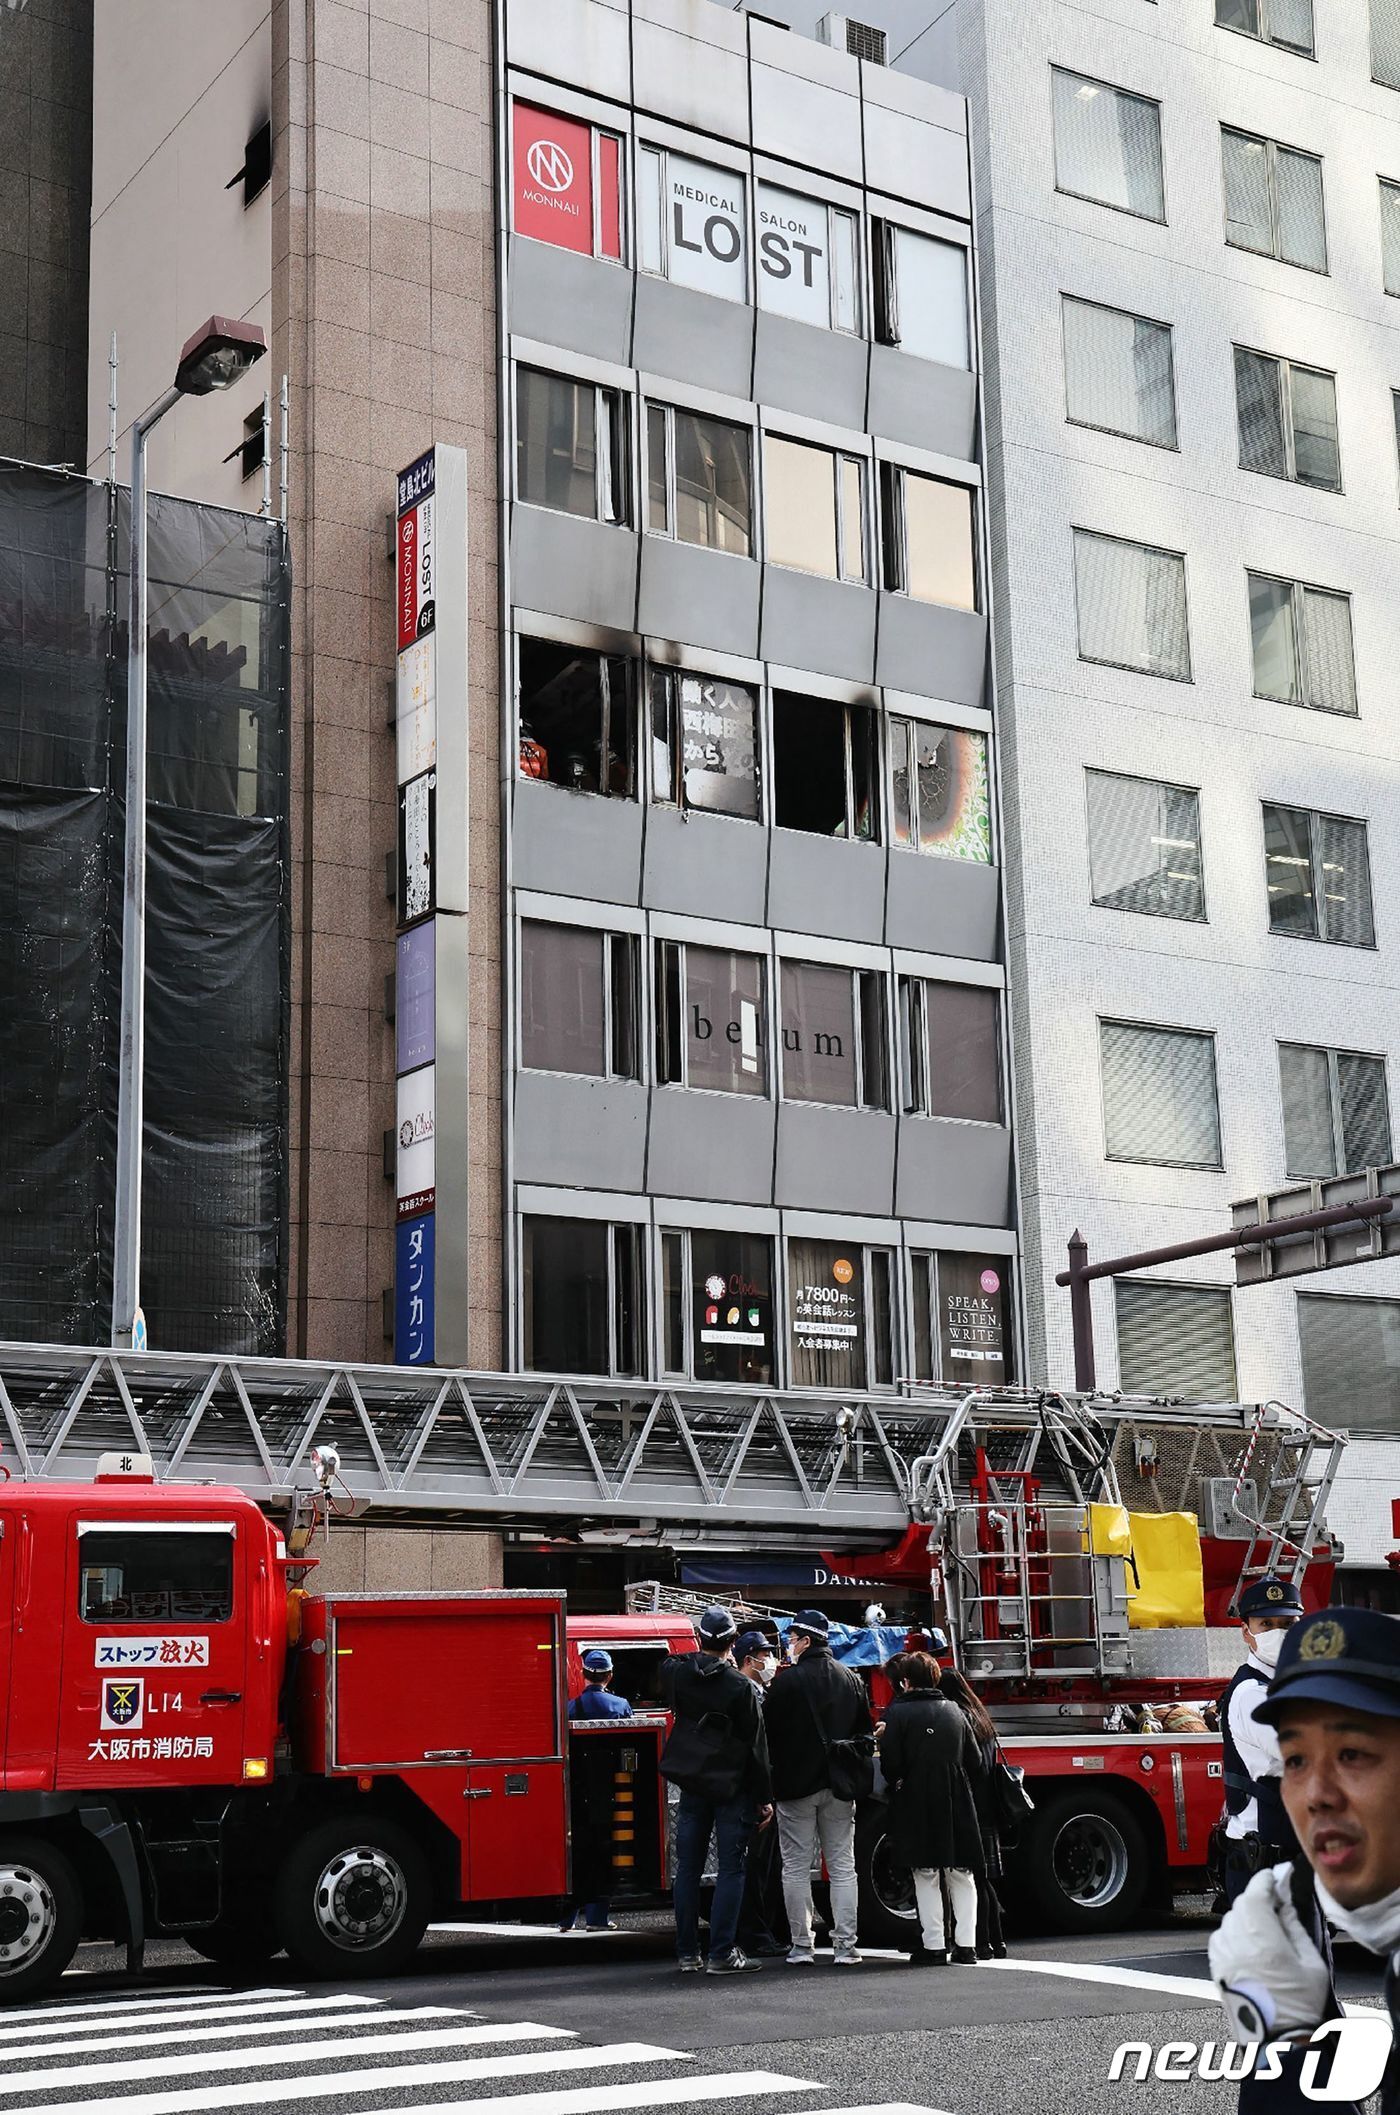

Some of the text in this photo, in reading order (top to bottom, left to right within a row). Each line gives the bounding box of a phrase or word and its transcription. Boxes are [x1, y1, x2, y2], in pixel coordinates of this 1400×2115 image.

[523, 188, 579, 216] MONNALI
[674, 183, 807, 236] MEDICAL SALON
[422, 541, 432, 595] LOST
[403, 546, 412, 632] MONNALI
[421, 608, 433, 628] 6F
[409, 1224, 425, 1361] ダンカン
[948, 1295, 994, 1312] SPEAK,
[796, 1303, 856, 1318] の英会話レッスン
[949, 1312, 1001, 1327] LISTEN,
[949, 1328, 998, 1341] WRITE.
[119, 1456, 132, 1471] 北
[99, 1640, 205, 1663] ストップ放火
[148, 1692, 182, 1713] L14
[87, 1736, 214, 1761] 大阪市消防局
